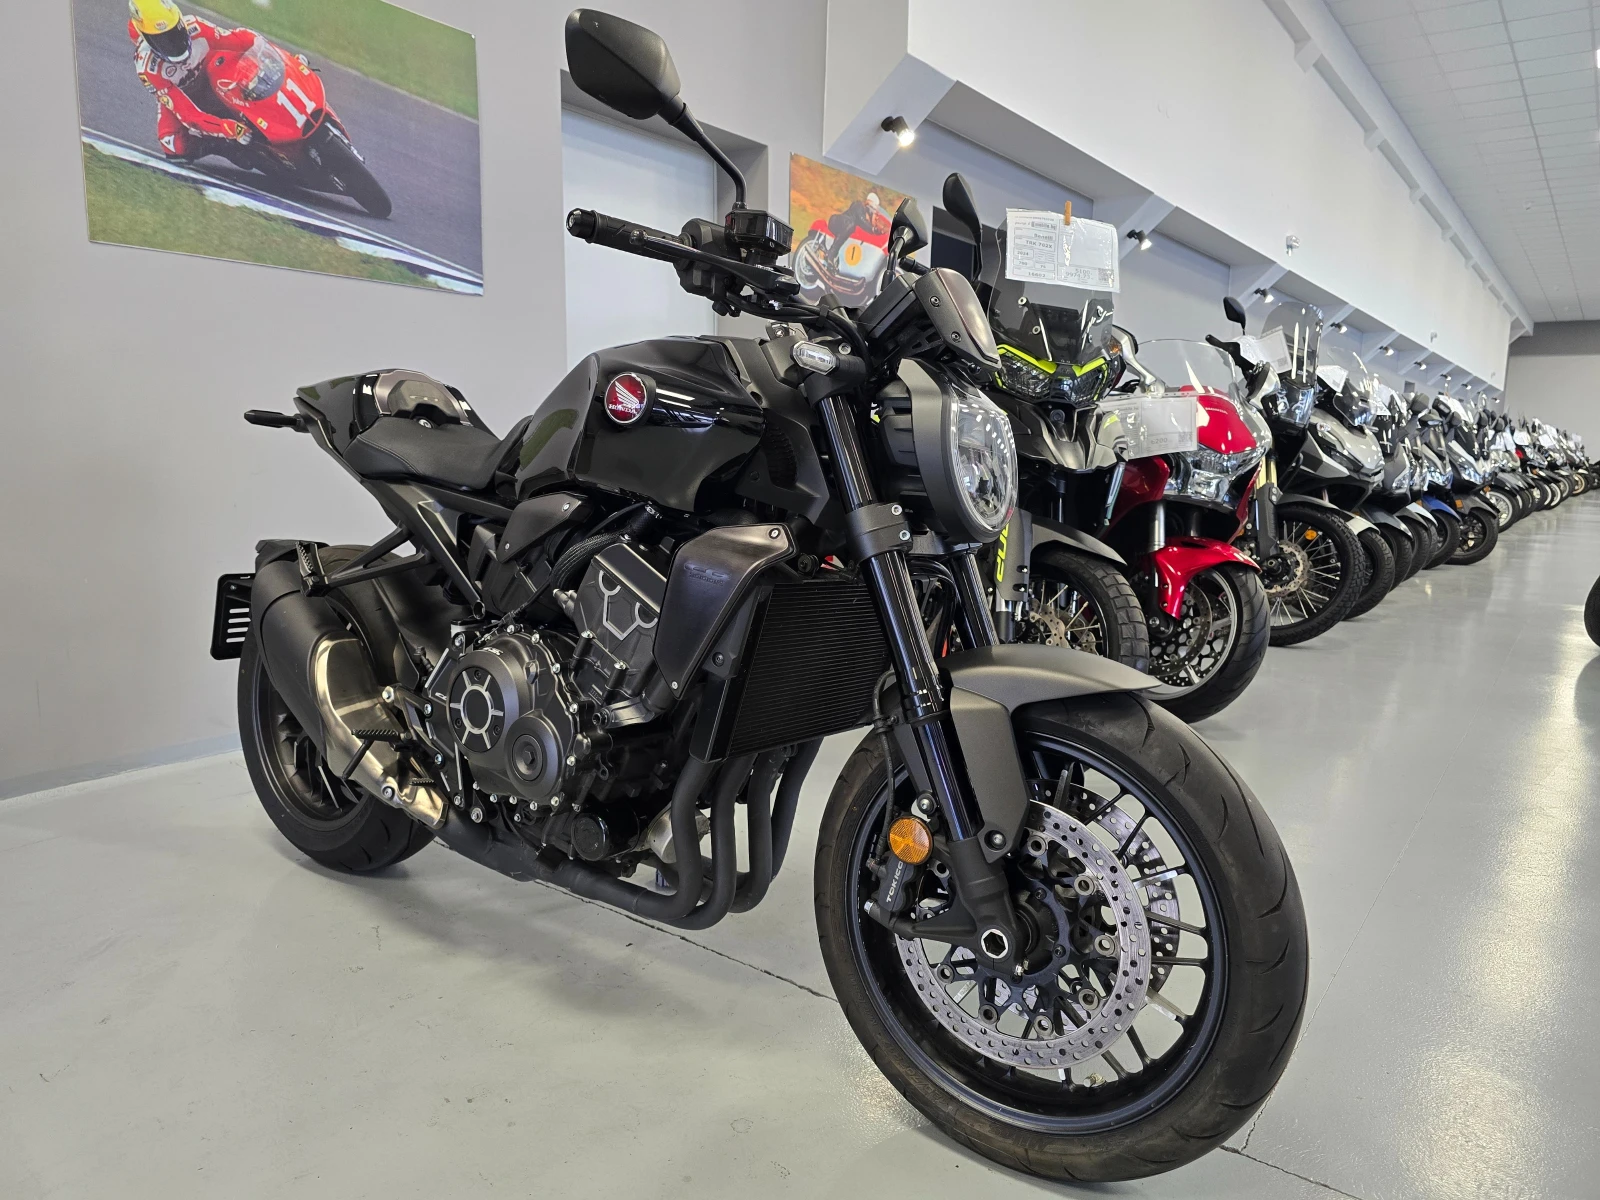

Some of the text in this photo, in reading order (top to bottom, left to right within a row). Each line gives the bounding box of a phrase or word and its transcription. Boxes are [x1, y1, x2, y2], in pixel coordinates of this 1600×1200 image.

[276, 77, 317, 129] 11
[608, 403, 637, 414] HONDA
[885, 861, 904, 903] TOKICO
